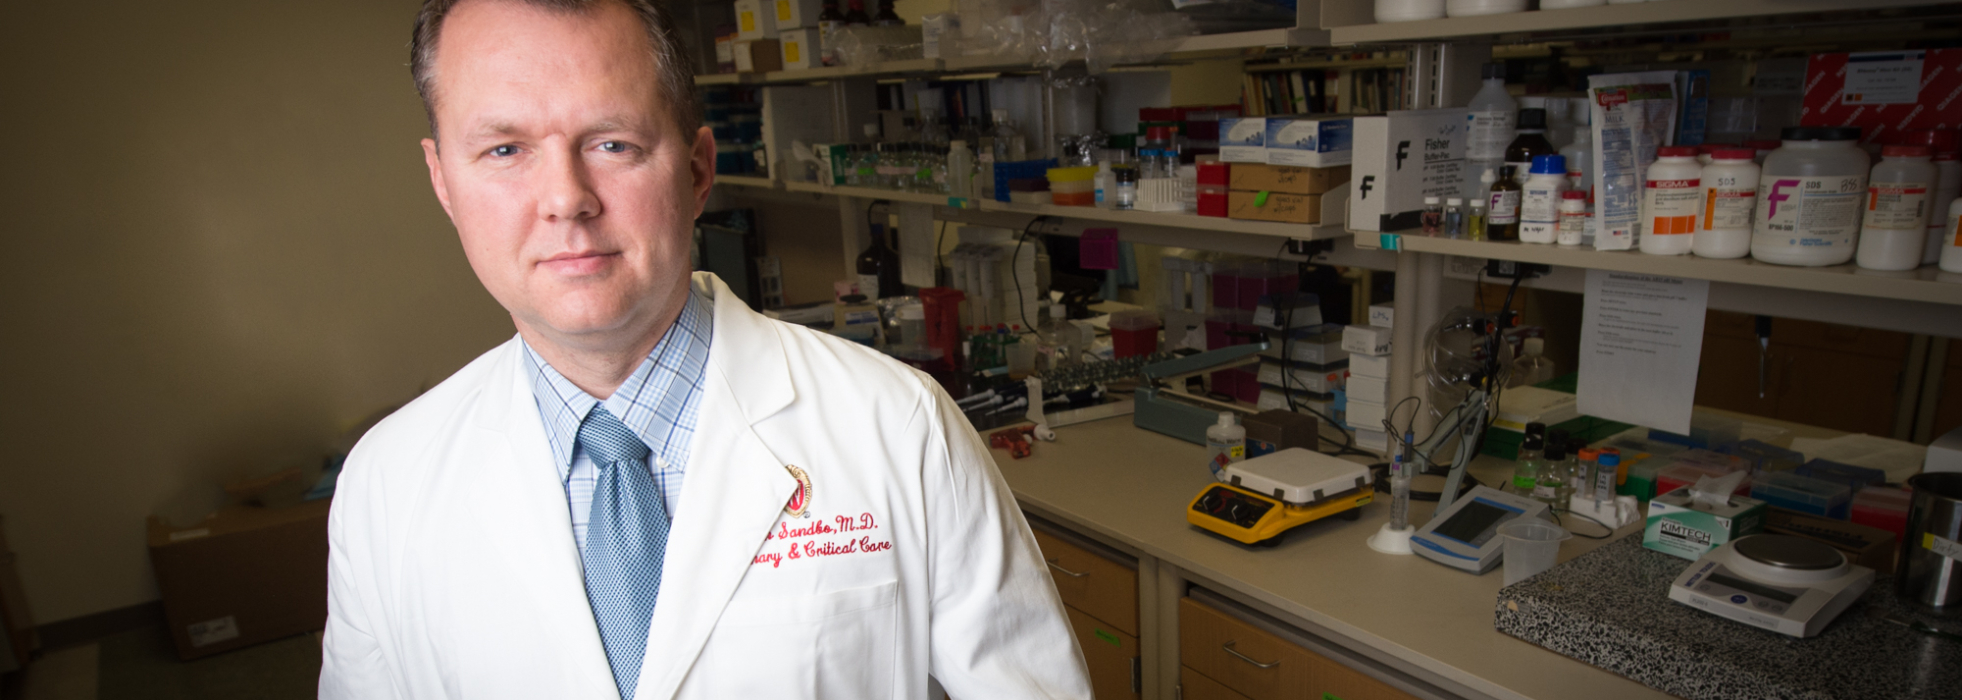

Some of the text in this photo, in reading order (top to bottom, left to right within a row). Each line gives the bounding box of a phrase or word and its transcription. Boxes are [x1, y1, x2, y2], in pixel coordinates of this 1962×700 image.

[1605, 115, 1625, 123] MILK
[1425, 137, 1450, 151] Fisher
[1424, 152, 1450, 161] Buffer-Pac
[1656, 180, 1689, 188] SIGMA
[1805, 181, 1822, 189] SDS
[1878, 187, 1905, 195] SIGMA
[1660, 521, 1711, 542] KIMTECH
[787, 541, 802, 560] &
[803, 537, 858, 558] Critical
[858, 535, 893, 554] Care
[1932, 538, 1959, 557] Dirty
